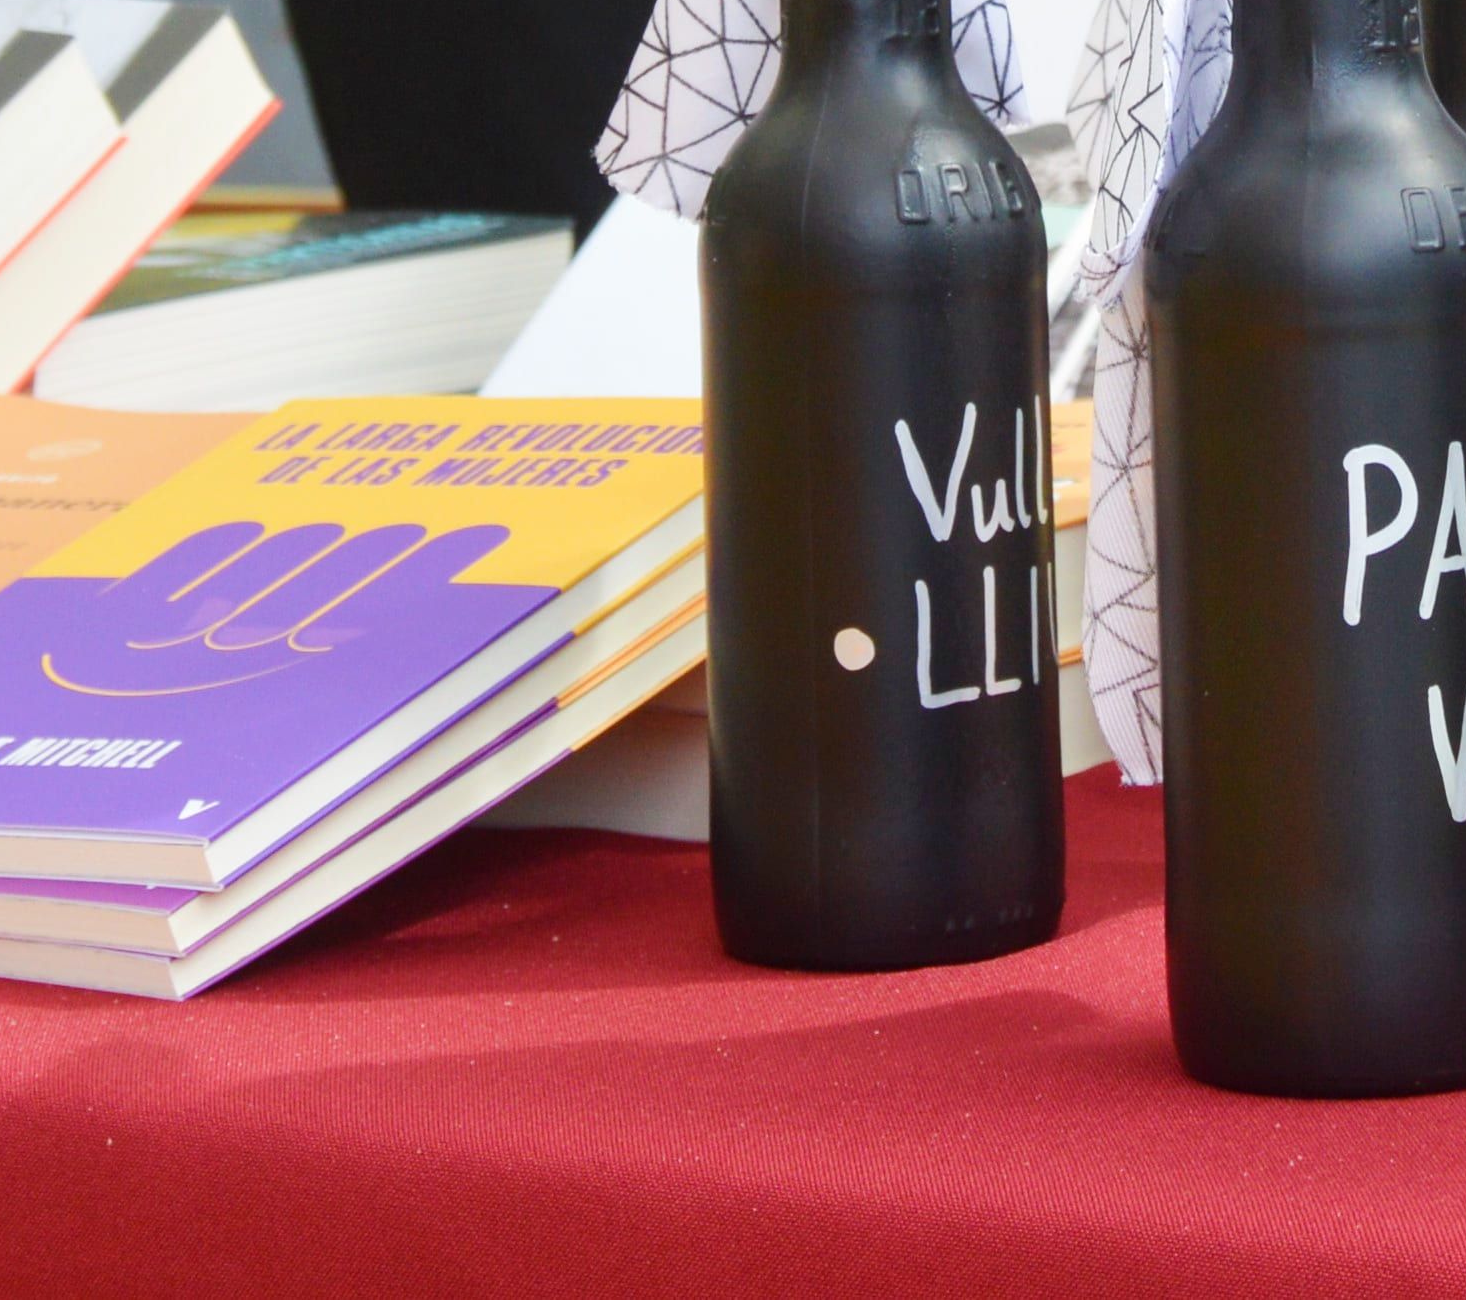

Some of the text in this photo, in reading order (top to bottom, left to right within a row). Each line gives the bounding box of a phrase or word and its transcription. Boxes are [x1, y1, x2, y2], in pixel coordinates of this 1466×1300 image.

[254, 423, 321, 452] LA
[315, 422, 462, 453] LARGA
[257, 455, 631, 488] DE LAS MUJERES
